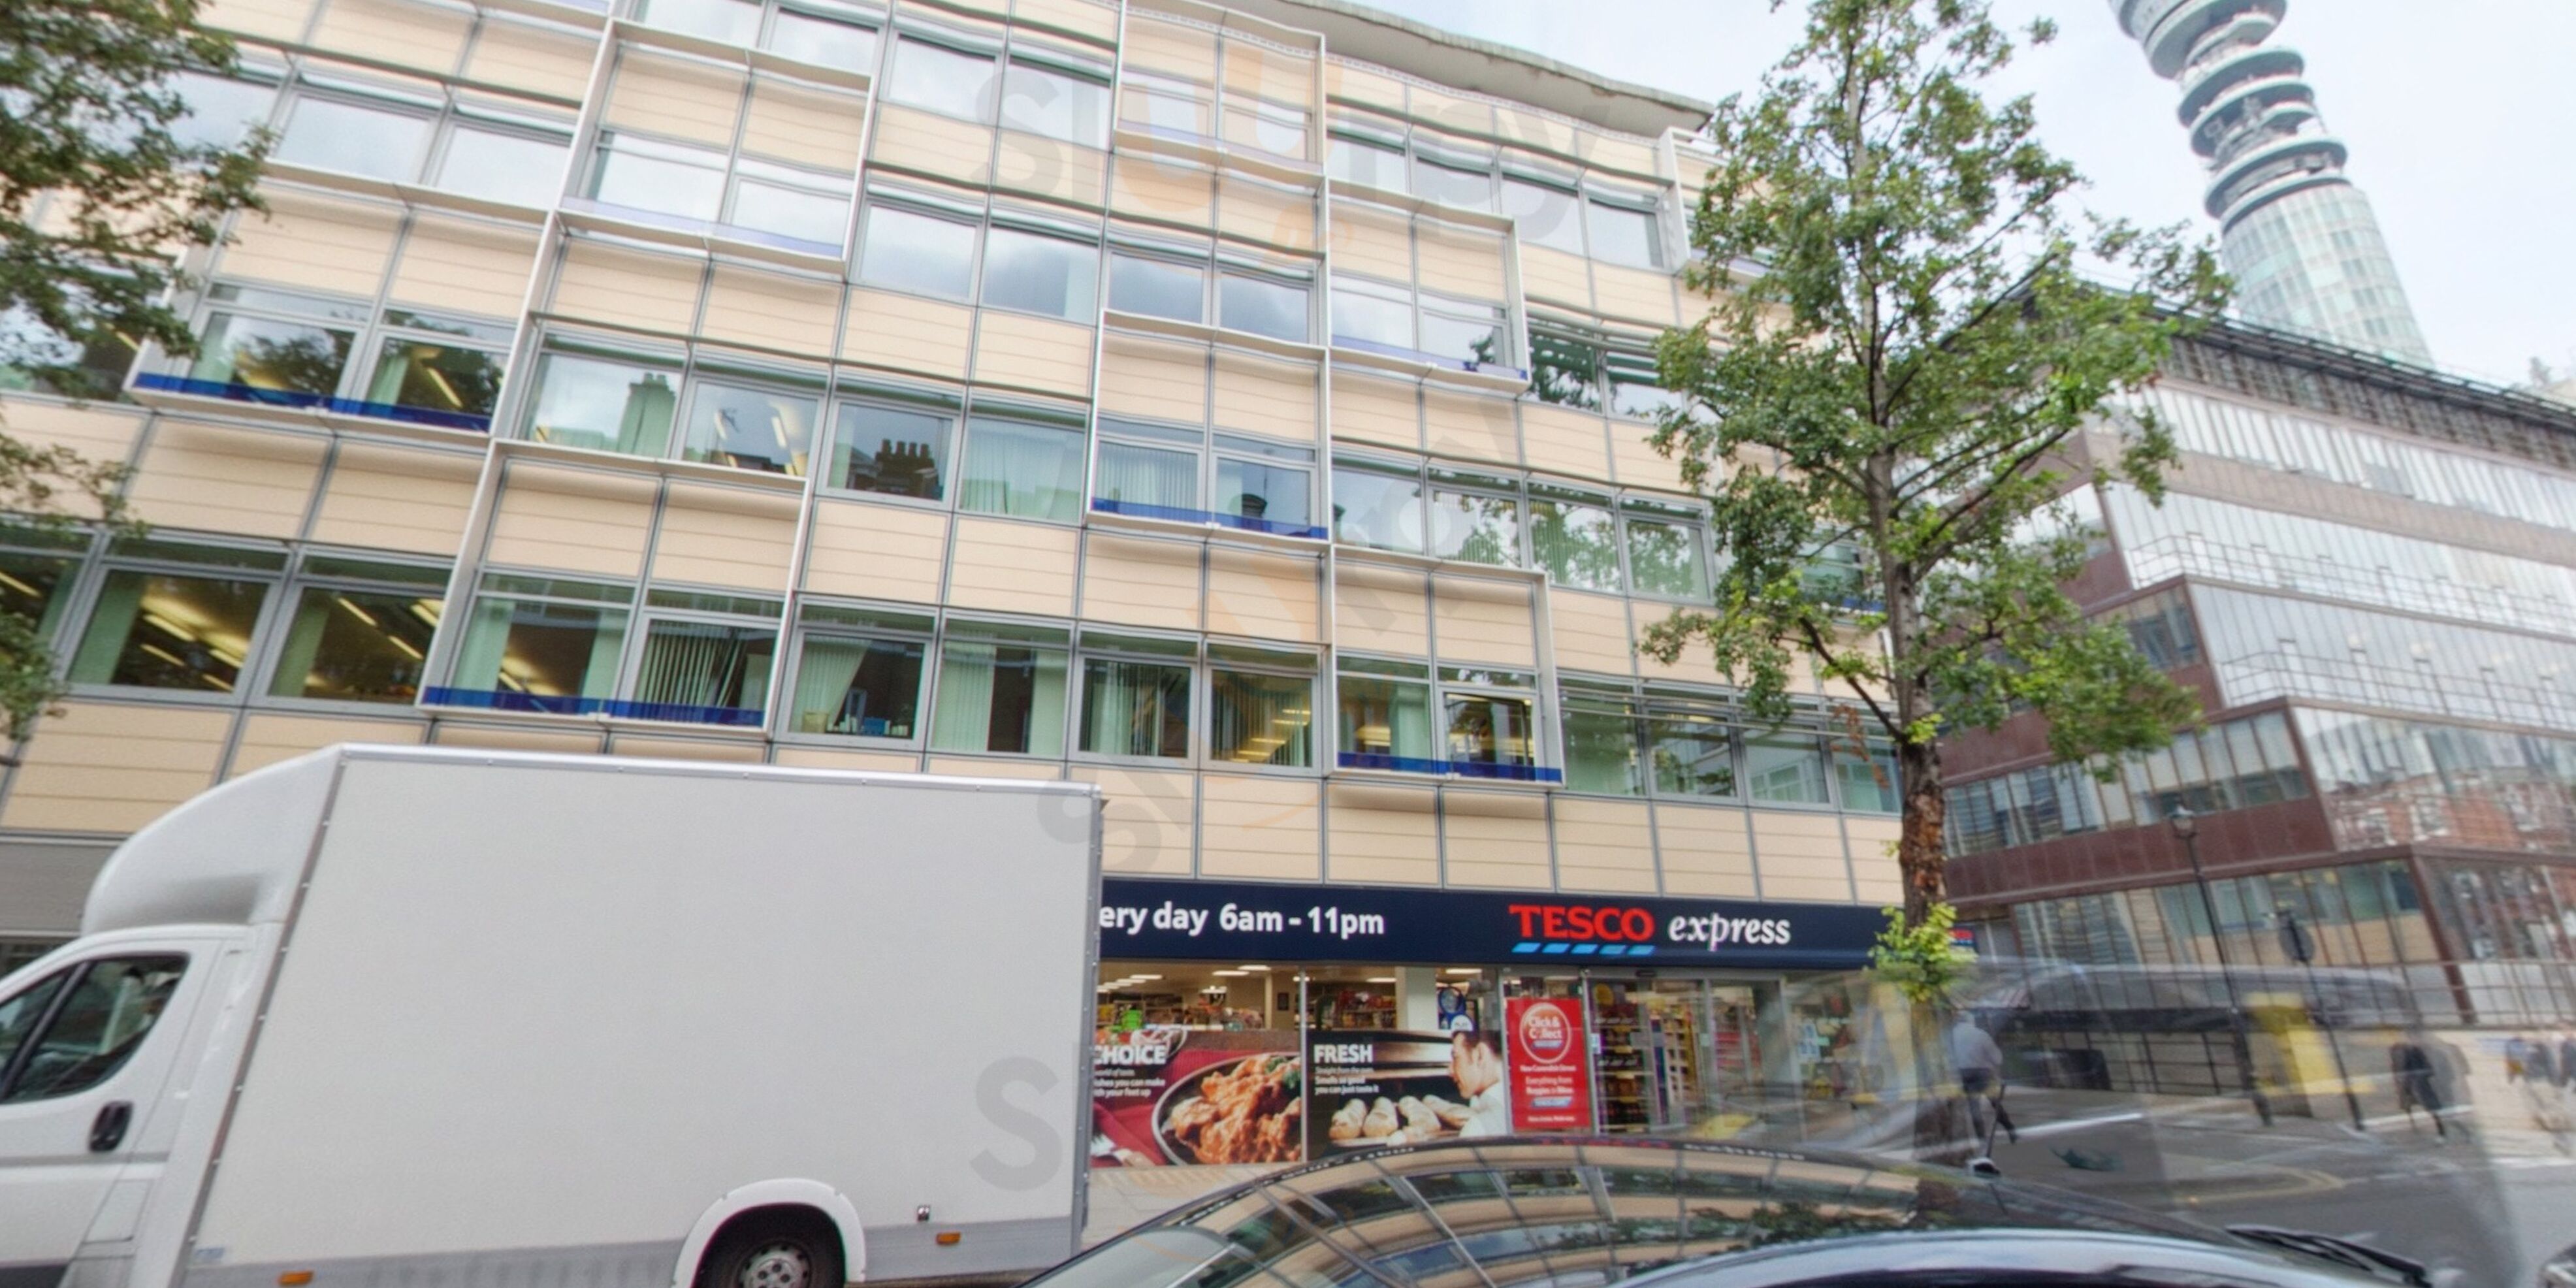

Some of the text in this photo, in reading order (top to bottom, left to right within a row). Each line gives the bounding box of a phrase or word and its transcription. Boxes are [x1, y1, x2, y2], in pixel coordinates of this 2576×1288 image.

[1153, 901, 1208, 936] day
[1219, 903, 1282, 932] 6am
[1288, 916, 1302, 926] -
[1308, 906, 1385, 940] 11pm
[1508, 904, 1791, 952] TESCO express
[1313, 1044, 1373, 1063] FRESH
[1314, 1087, 1328, 1096] you
